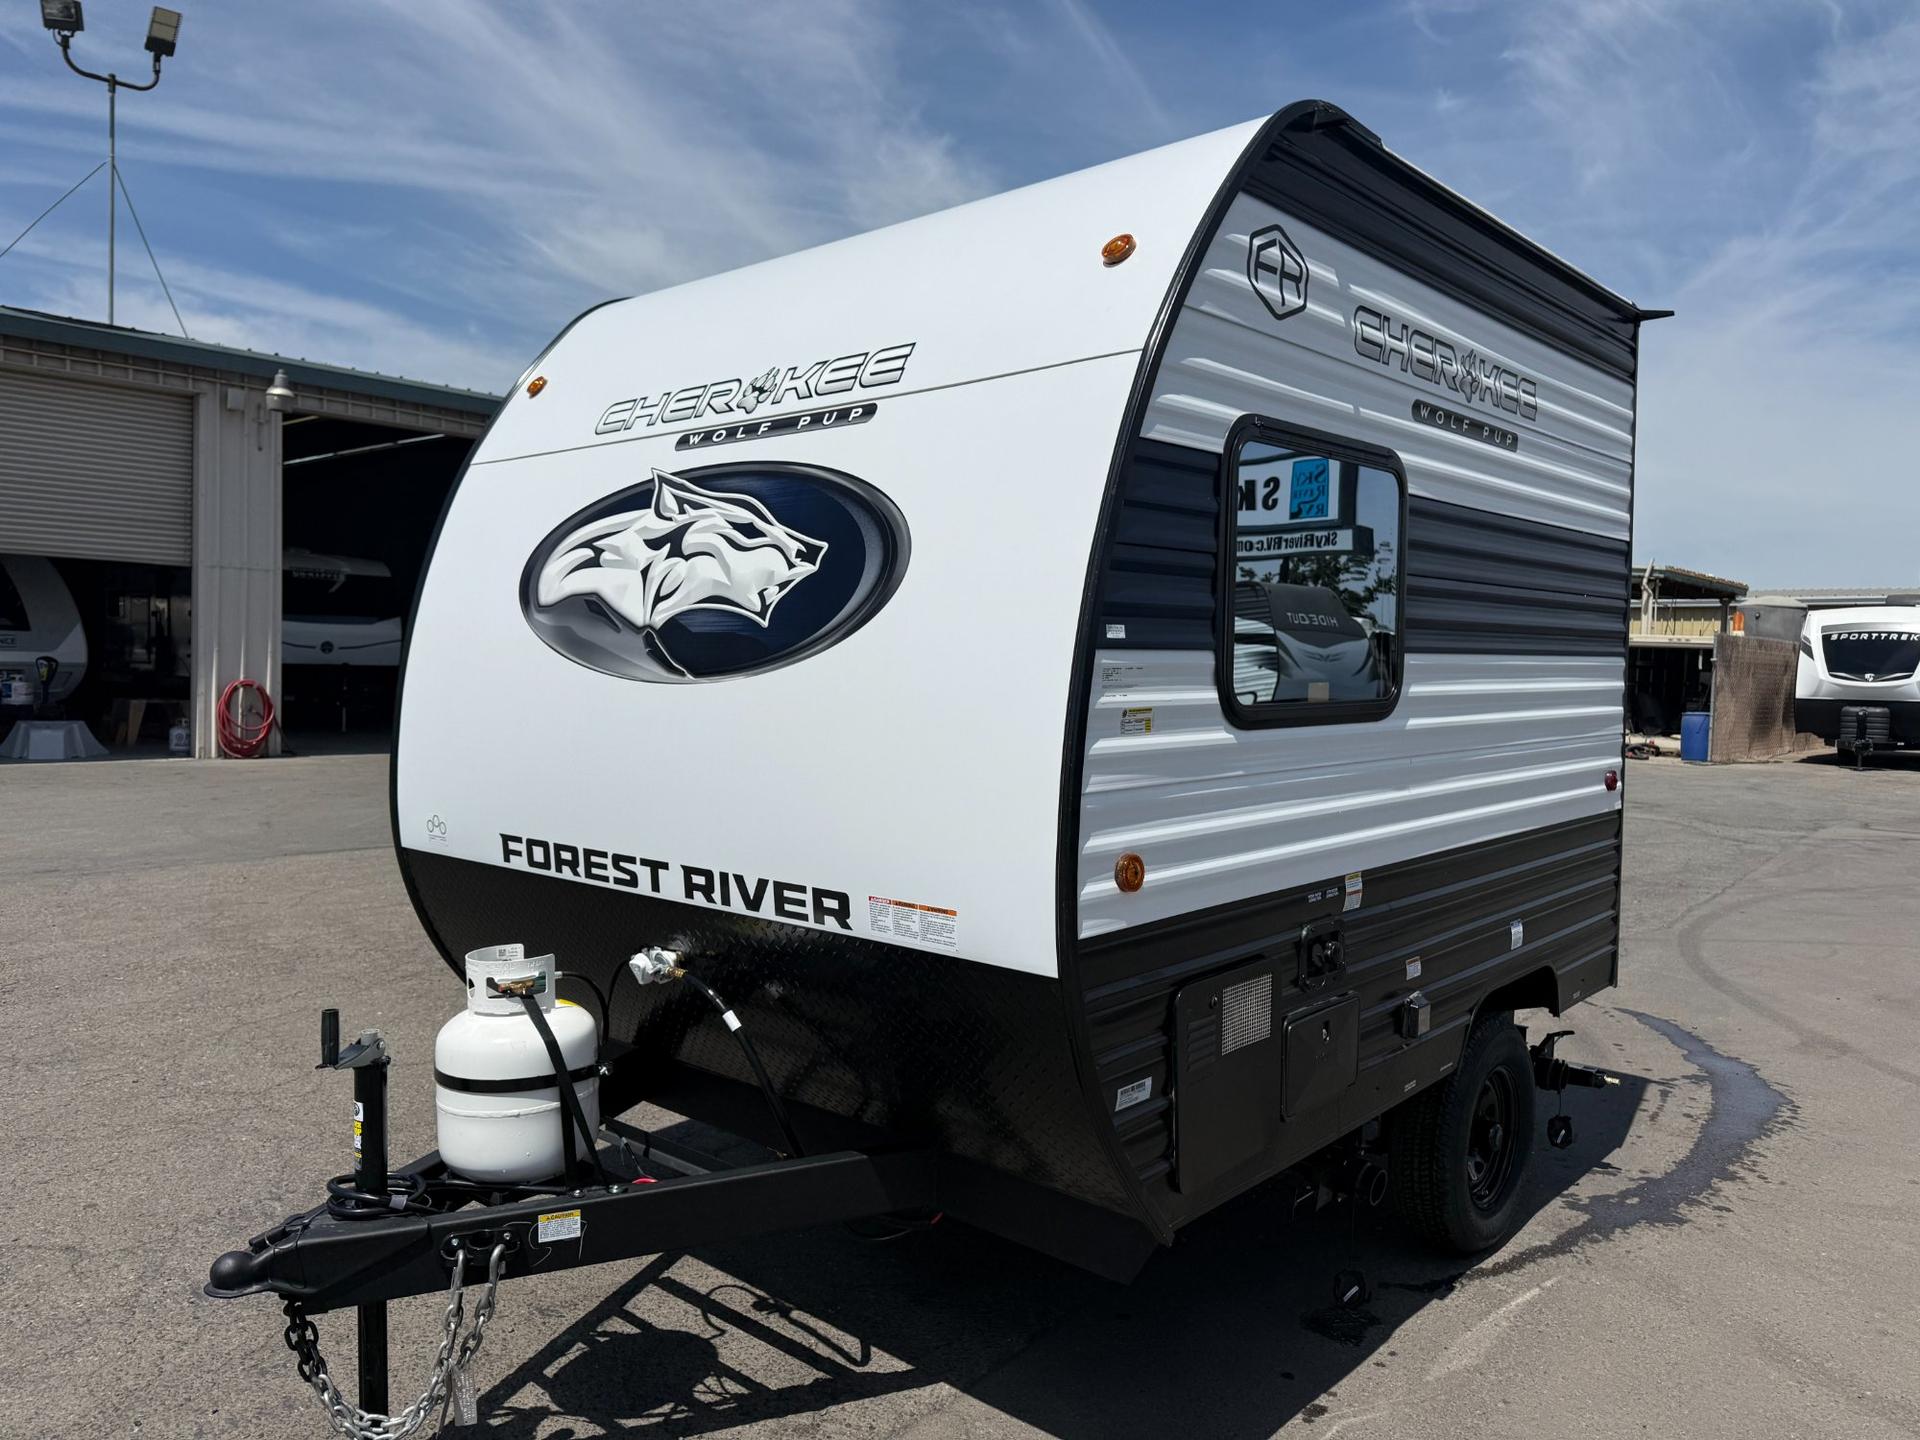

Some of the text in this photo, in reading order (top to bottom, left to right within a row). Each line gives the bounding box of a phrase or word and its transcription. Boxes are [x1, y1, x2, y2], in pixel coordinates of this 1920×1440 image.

[595, 342, 916, 435] CHEROKEE
[688, 407, 863, 446] WOLF PUP
[1420, 404, 1512, 446] WOLF PUP
[1830, 633, 1920, 641] SPORTTREK
[499, 833, 669, 893] FOREST
[680, 864, 853, 931] RIVER
